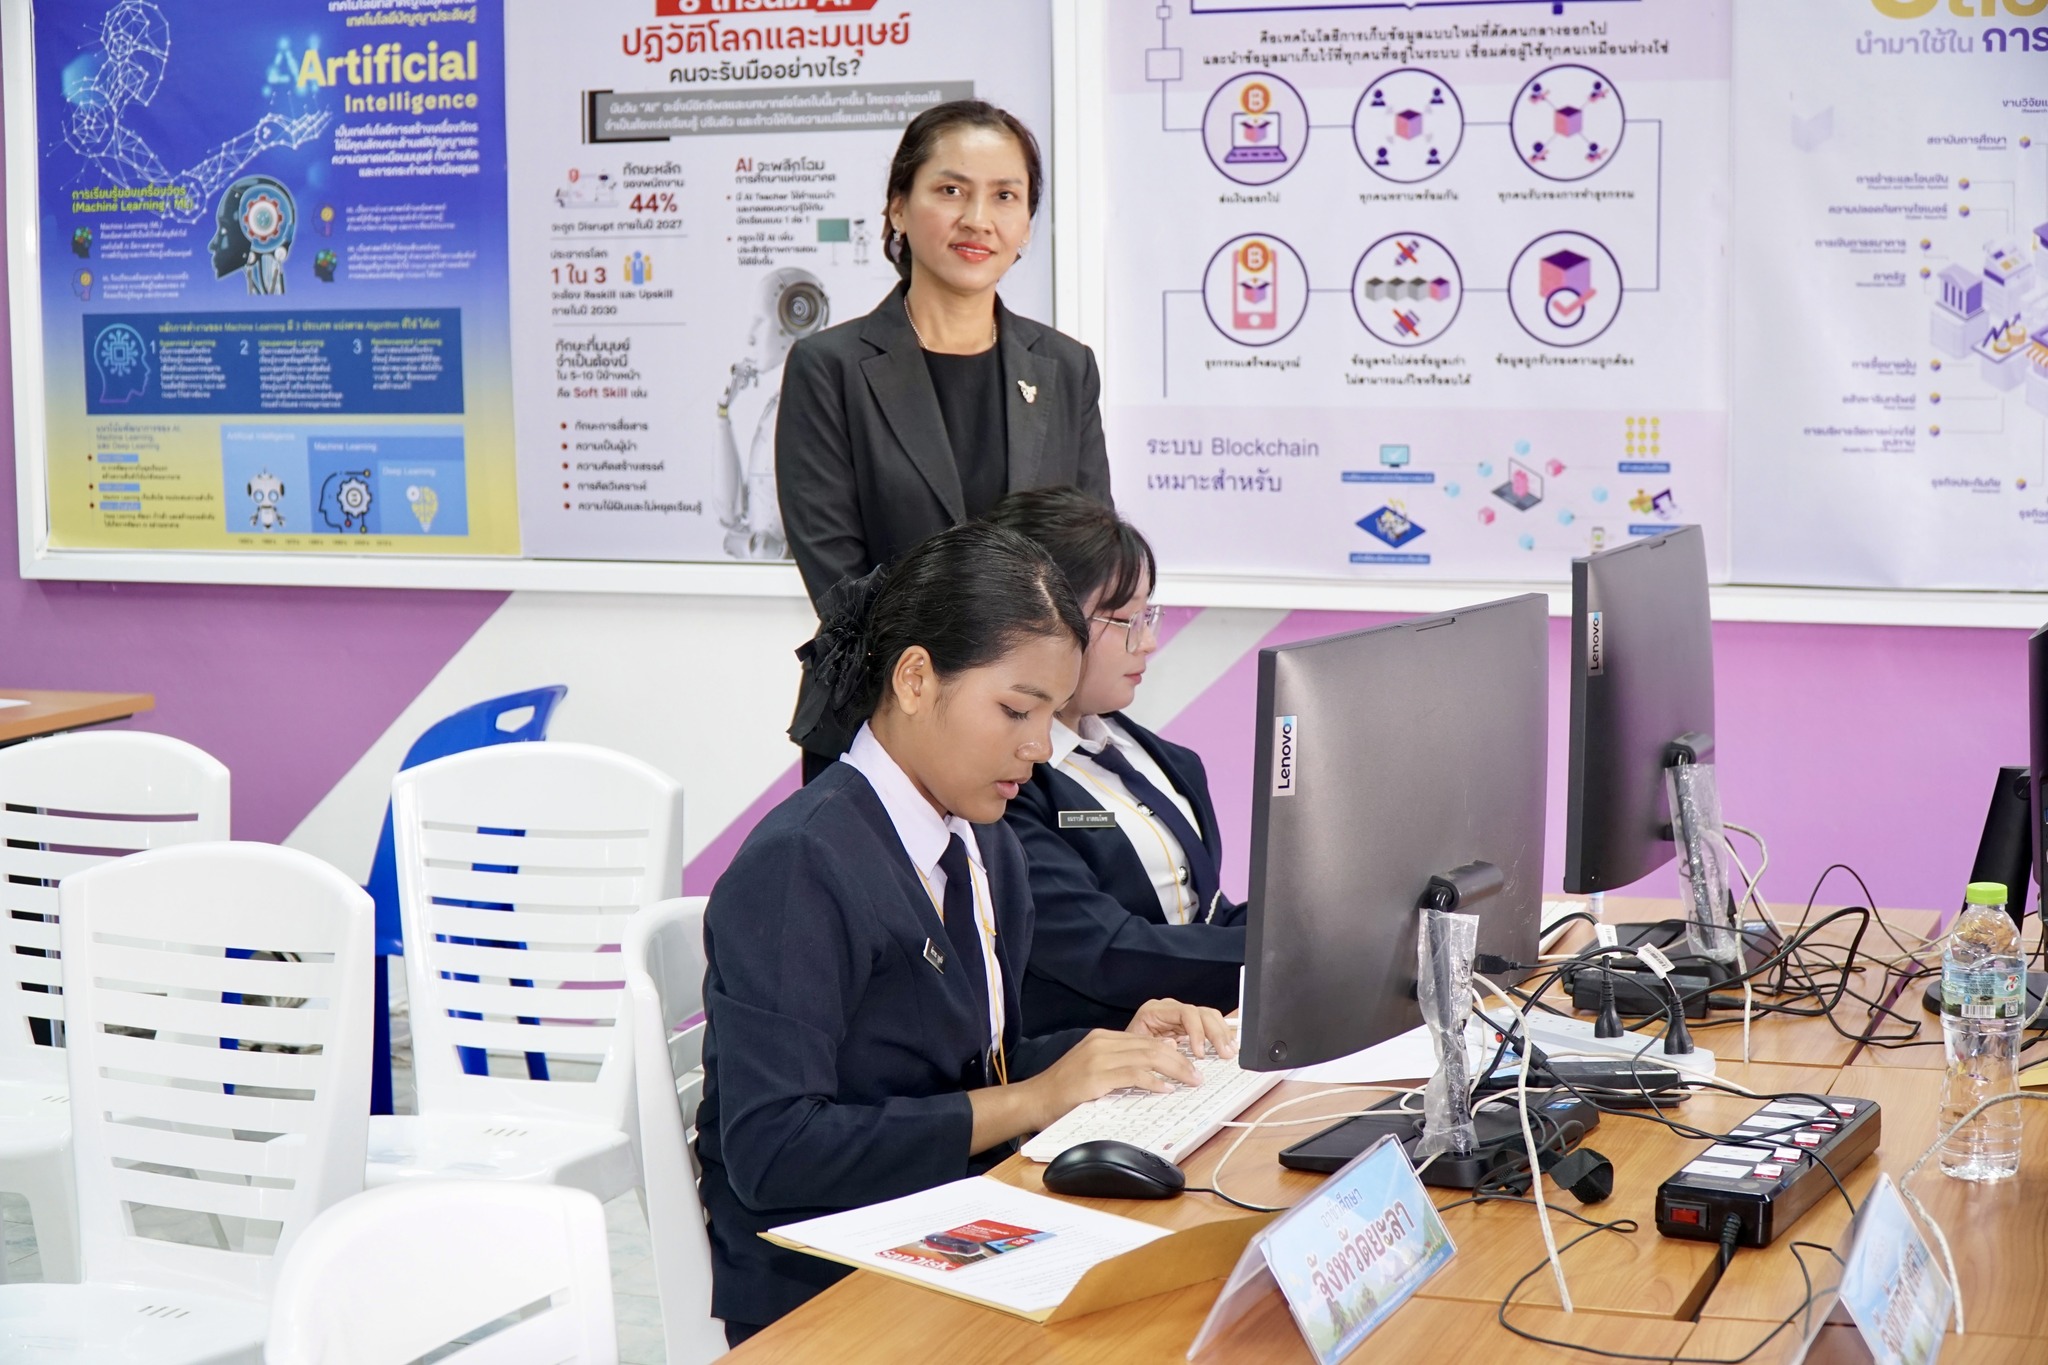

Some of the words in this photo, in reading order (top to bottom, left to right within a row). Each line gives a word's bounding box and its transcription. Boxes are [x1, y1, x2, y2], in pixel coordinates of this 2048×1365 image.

[345, 6, 477, 27] เทคโนโลยีปัญญาประดิษฐ์
[622, 12, 911, 63] ปฏิวัติโลกและมนุษย์
[1856, 28, 1974, 55] นำมาใช้ใน
[297, 40, 478, 88] Artificial
[669, 55, 861, 83] คนจะรับมืออย่างไร?
[344, 90, 478, 115] Intelligence
[622, 161, 682, 176] ทักษะหลัก
[735, 157, 752, 173] AI
[757, 156, 825, 173] จะพลิกโฉม
[623, 177, 685, 188] ของพนักงาน
[629, 193, 678, 213] 44%
[755, 192, 788, 200] Teacher
[72, 202, 118, 214] (Machine
[120, 200, 164, 212] Learning
[577, 220, 614, 233] Disrupt
[655, 219, 682, 229] 2027
[550, 247, 608, 260] ประชากรโลก
[551, 268, 560, 284] 1
[566, 263, 588, 284] ใน
[594, 267, 607, 284] 3
[584, 290, 616, 299] Reskill
[639, 289, 673, 301] Upskill
[590, 305, 618, 316] 2030
[149, 340, 156, 354] 1
[240, 340, 249, 355] 2
[353, 338, 362, 355] 3
[555, 335, 631, 355] ทักษะที่มนุษย์
[556, 354, 628, 368] จำเป็นต้องมี
[573, 387, 599, 398] Soft
[602, 387, 627, 398] Skill
[313, 441, 344, 451] Machine
[345, 442, 377, 453] Learning
[1146, 438, 1202, 456] ระบบ
[1211, 437, 1320, 457] Blockchain
[382, 466, 402, 476] Deep
[403, 467, 437, 477] Learning
[1146, 467, 1282, 492] เหมาะสำหรับ
[1591, 618, 1601, 671] Lenovo
[1278, 722, 1292, 790] Lenovo
[878, 1250, 957, 1271] SanDisk
